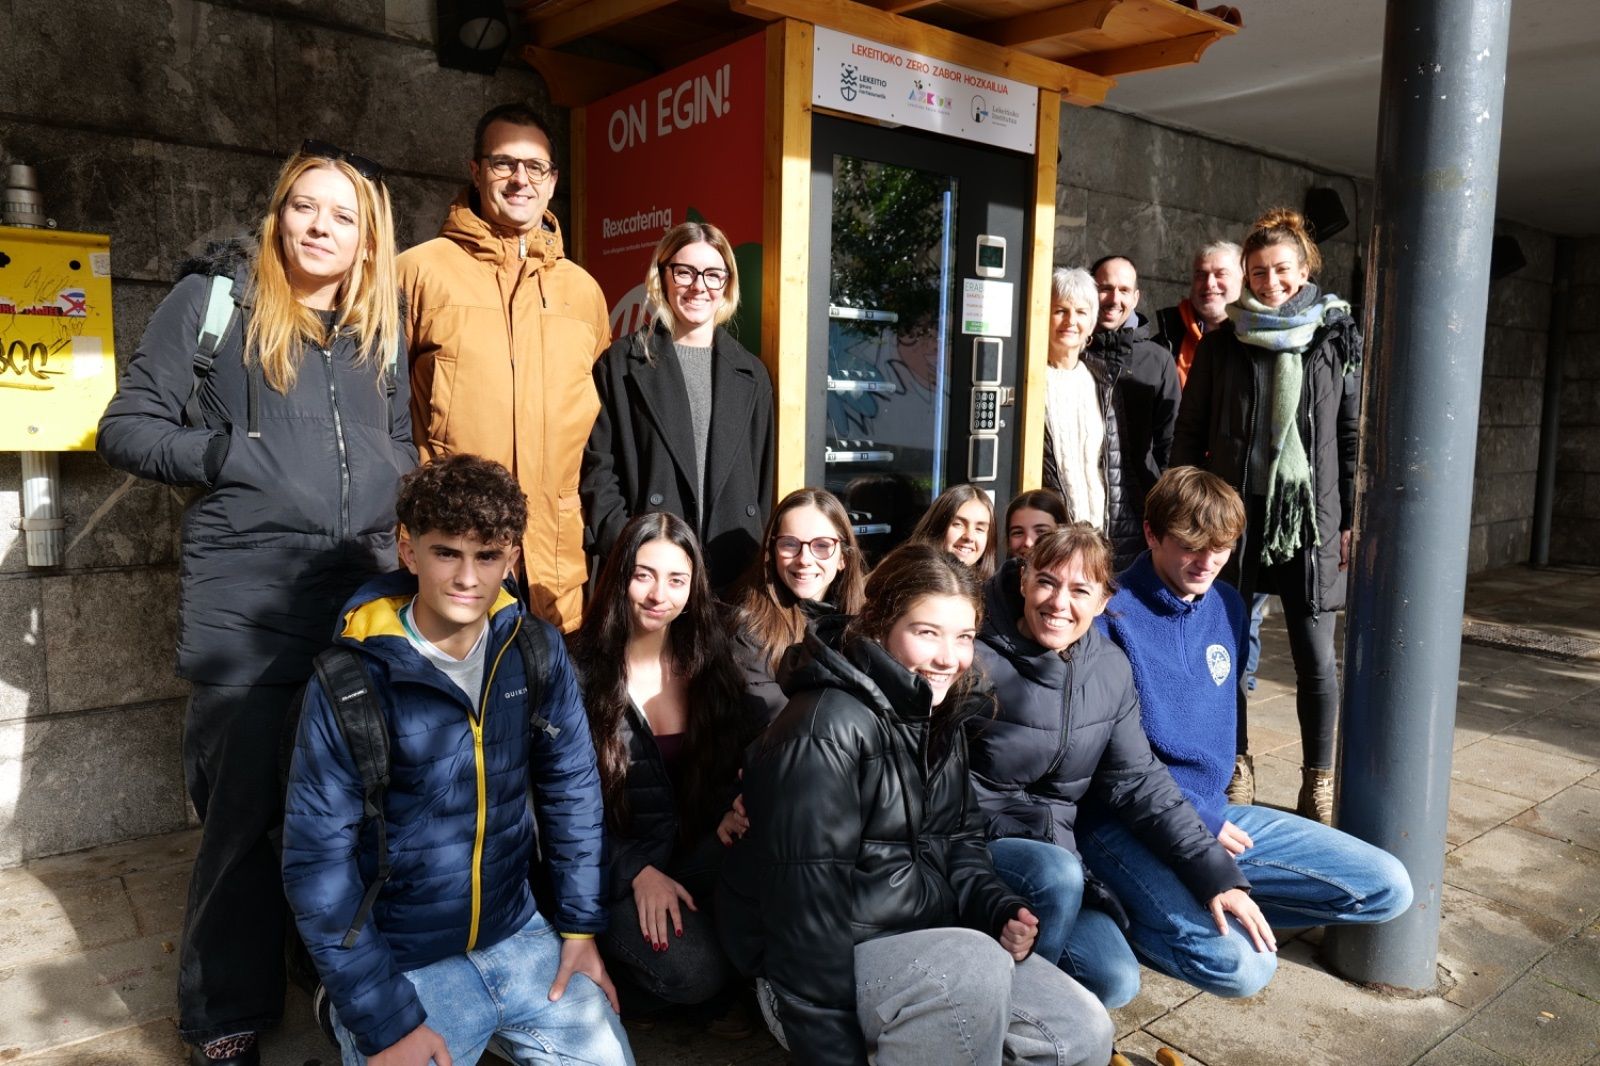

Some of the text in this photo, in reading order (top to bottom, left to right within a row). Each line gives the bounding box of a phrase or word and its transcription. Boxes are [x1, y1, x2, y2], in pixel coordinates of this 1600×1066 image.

[851, 43, 1009, 95] LEKEITIOKO ZERO ZABOR HOZKAILUA
[859, 74, 887, 88] LEKEITIO
[608, 63, 730, 153] ON EGIN!
[602, 204, 672, 239] Rexcatering
